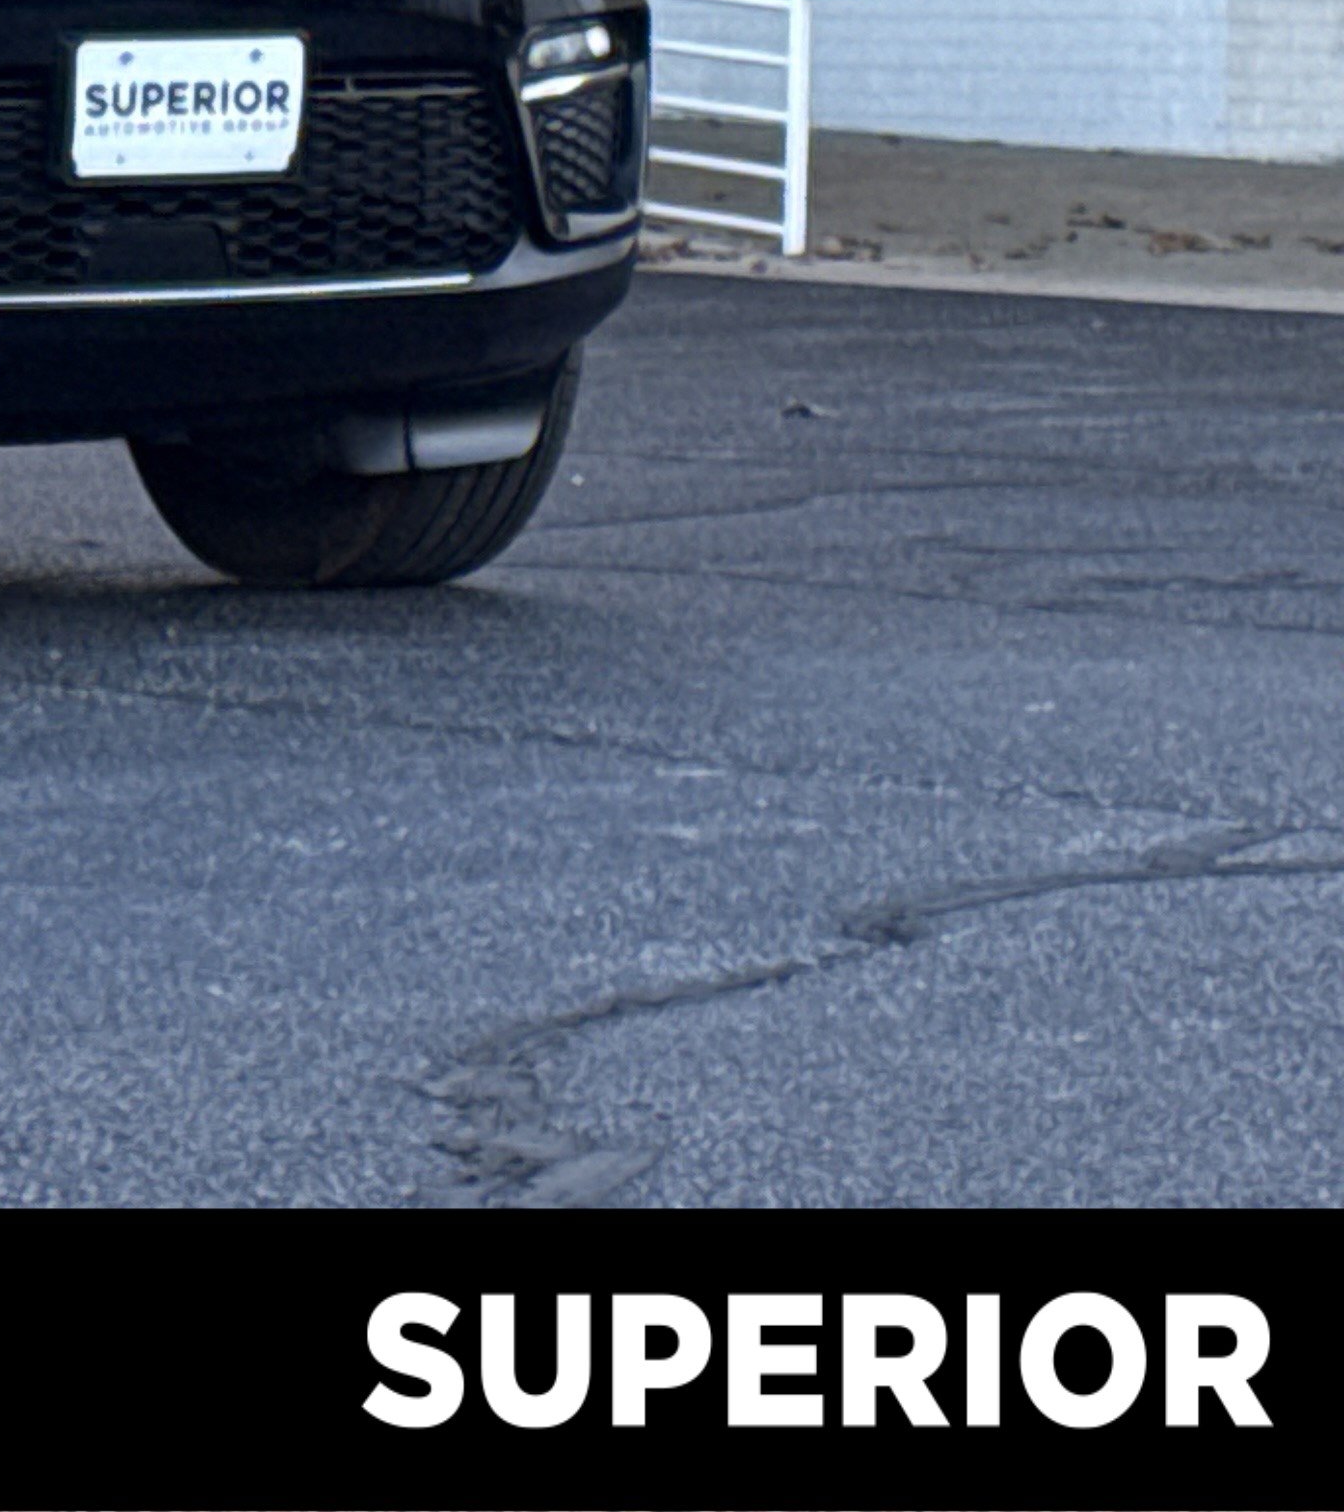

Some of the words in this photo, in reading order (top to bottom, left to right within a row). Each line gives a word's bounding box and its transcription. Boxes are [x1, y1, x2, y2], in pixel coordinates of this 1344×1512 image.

[84, 80, 289, 118] SUPERIOR
[84, 120, 211, 136] AUTOMOTIVE
[223, 118, 289, 133] GROUP
